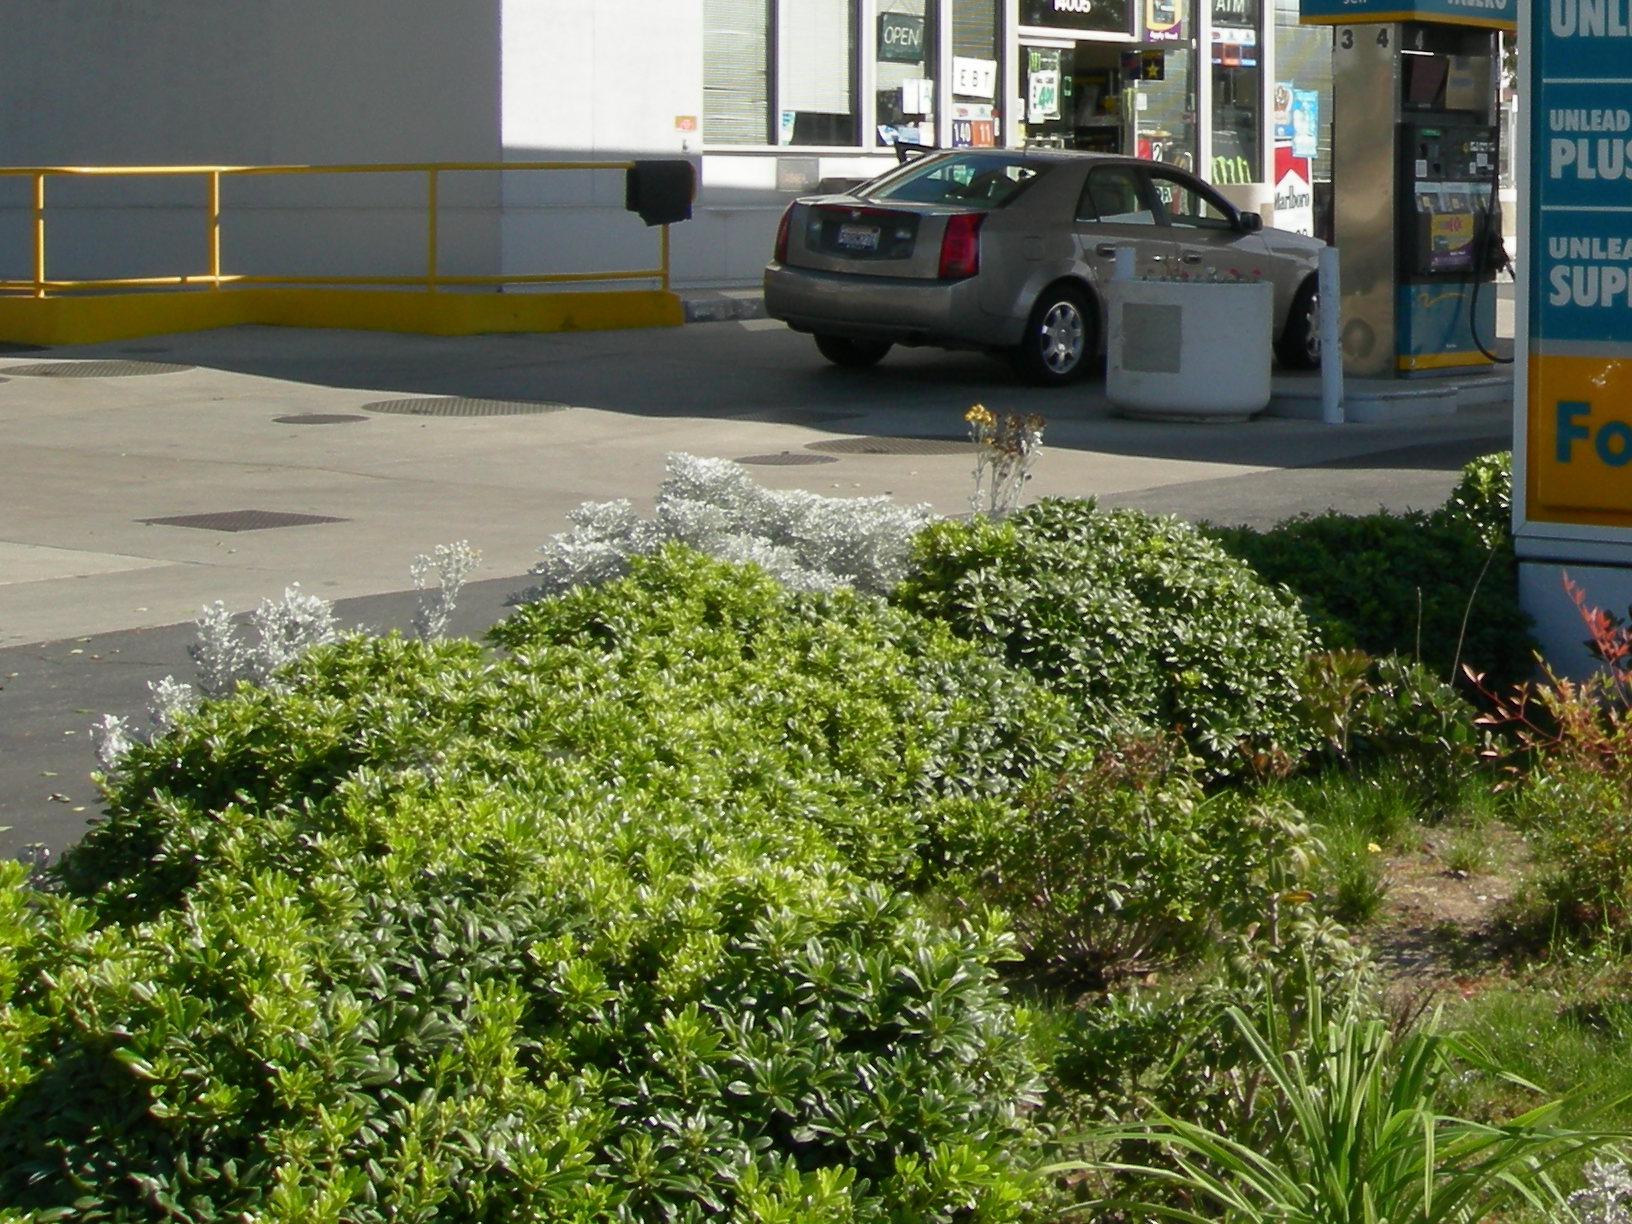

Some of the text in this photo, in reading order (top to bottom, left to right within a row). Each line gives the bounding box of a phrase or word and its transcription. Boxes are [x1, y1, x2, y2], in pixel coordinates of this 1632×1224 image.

[884, 26, 921, 46] OPEN
[1341, 28, 1389, 49] 3 4
[1550, 109, 1631, 132] UNLEAD
